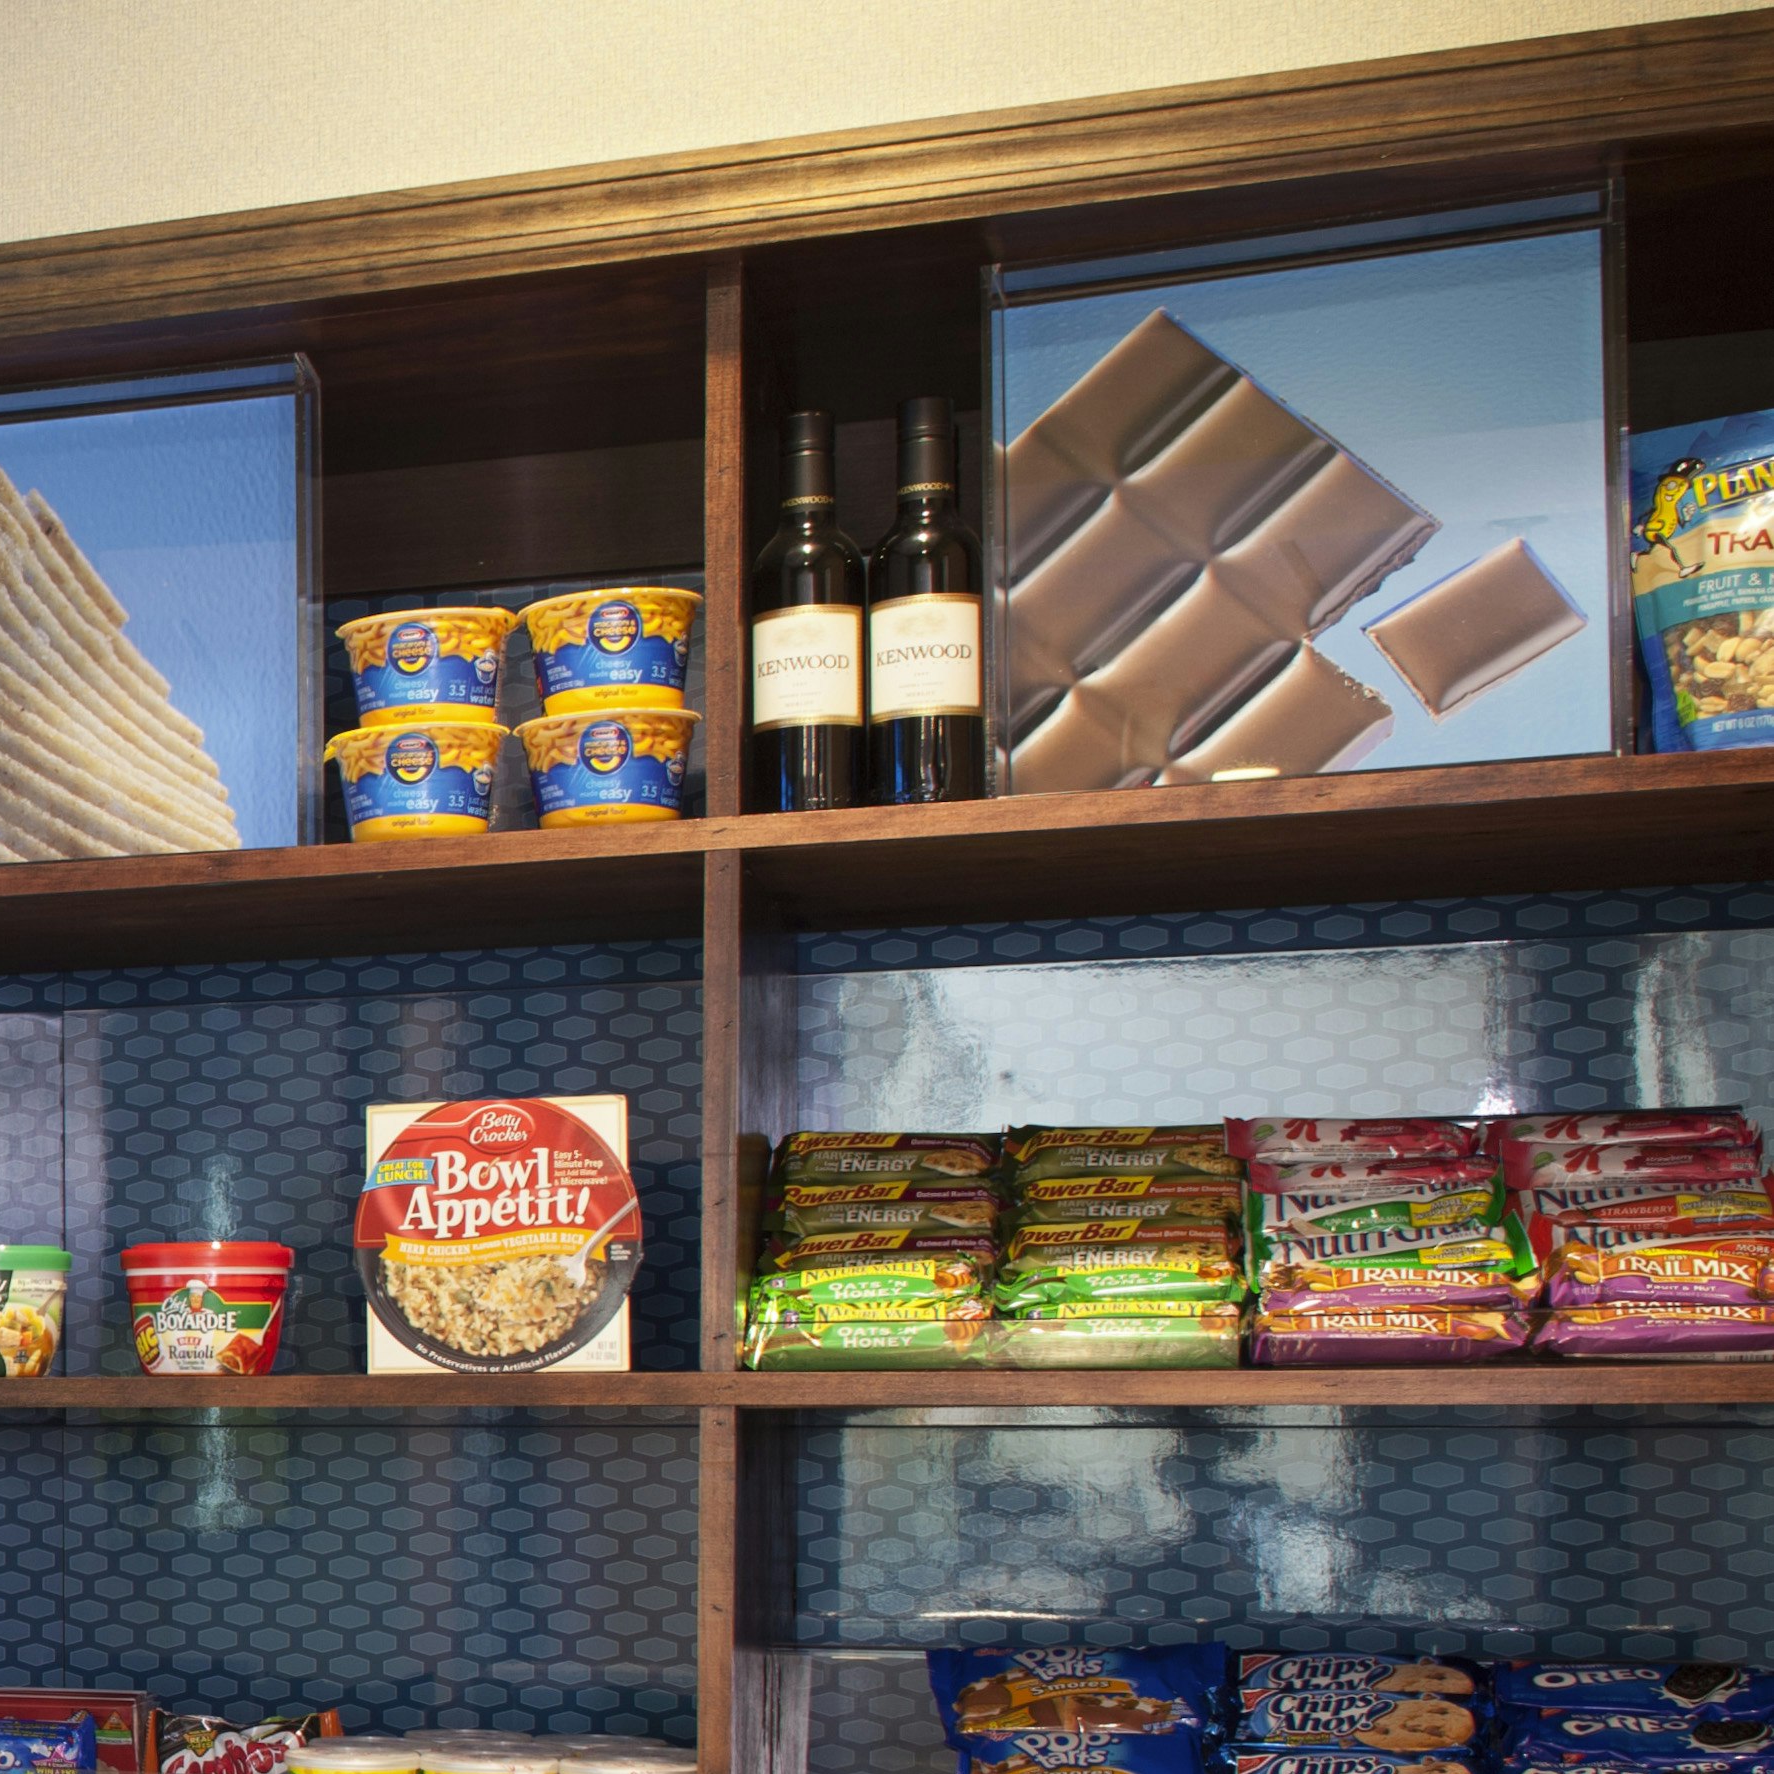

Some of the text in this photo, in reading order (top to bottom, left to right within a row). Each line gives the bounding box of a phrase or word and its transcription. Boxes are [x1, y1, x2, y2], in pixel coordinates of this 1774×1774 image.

[1698, 573, 1762, 593] FRUIT &
[876, 644, 972, 667] KENWOOD
[610, 668, 643, 681] easy
[757, 655, 850, 679] KENWOOD
[407, 687, 439, 702] easy
[449, 684, 466, 697] 3.5
[599, 787, 632, 801] easy
[406, 798, 438, 812] easy
[481, 1112, 521, 1131] Betty
[470, 1130, 528, 1144] Crocker
[553, 1151, 571, 1161] Easy
[1087, 1152, 1166, 1166] ENERGY
[378, 1163, 404, 1172] GREAT
[432, 1148, 552, 1195] Bowl
[553, 1160, 603, 1169] Minute Prep
[839, 1158, 916, 1173] ENERGY
[376, 1170, 428, 1184] LUNCH!
[560, 1177, 608, 1185] Microwave!
[399, 1186, 590, 1239] Appétit!
[846, 1207, 923, 1223] ENERGY
[1089, 1202, 1170, 1217] ENERGY
[1600, 1205, 1675, 1217] STRAWBERRY
[400, 1233, 584, 1256] HERB CHICKEN VEGETABLE RICE
[805, 1260, 933, 1283] NATURE VALLEY
[1618, 1256, 1751, 1280] TRAIL MIX
[1350, 1268, 1492, 1285] TRAIL MIX
[161, 1297, 190, 1314] Chef
[157, 1311, 237, 1333] BOYARDEE
[1308, 1314, 1439, 1332] TRAIL MIX
[842, 1334, 913, 1349] HONEY
[169, 1345, 215, 1359] Ravioli
[415, 1342, 576, 1373] No Preservatives or Artificial Flavors
[1532, 1667, 1662, 1689] OREO
[1031, 1680, 1112, 1696] S'mores
[1036, 1746, 1108, 1768] tarts
